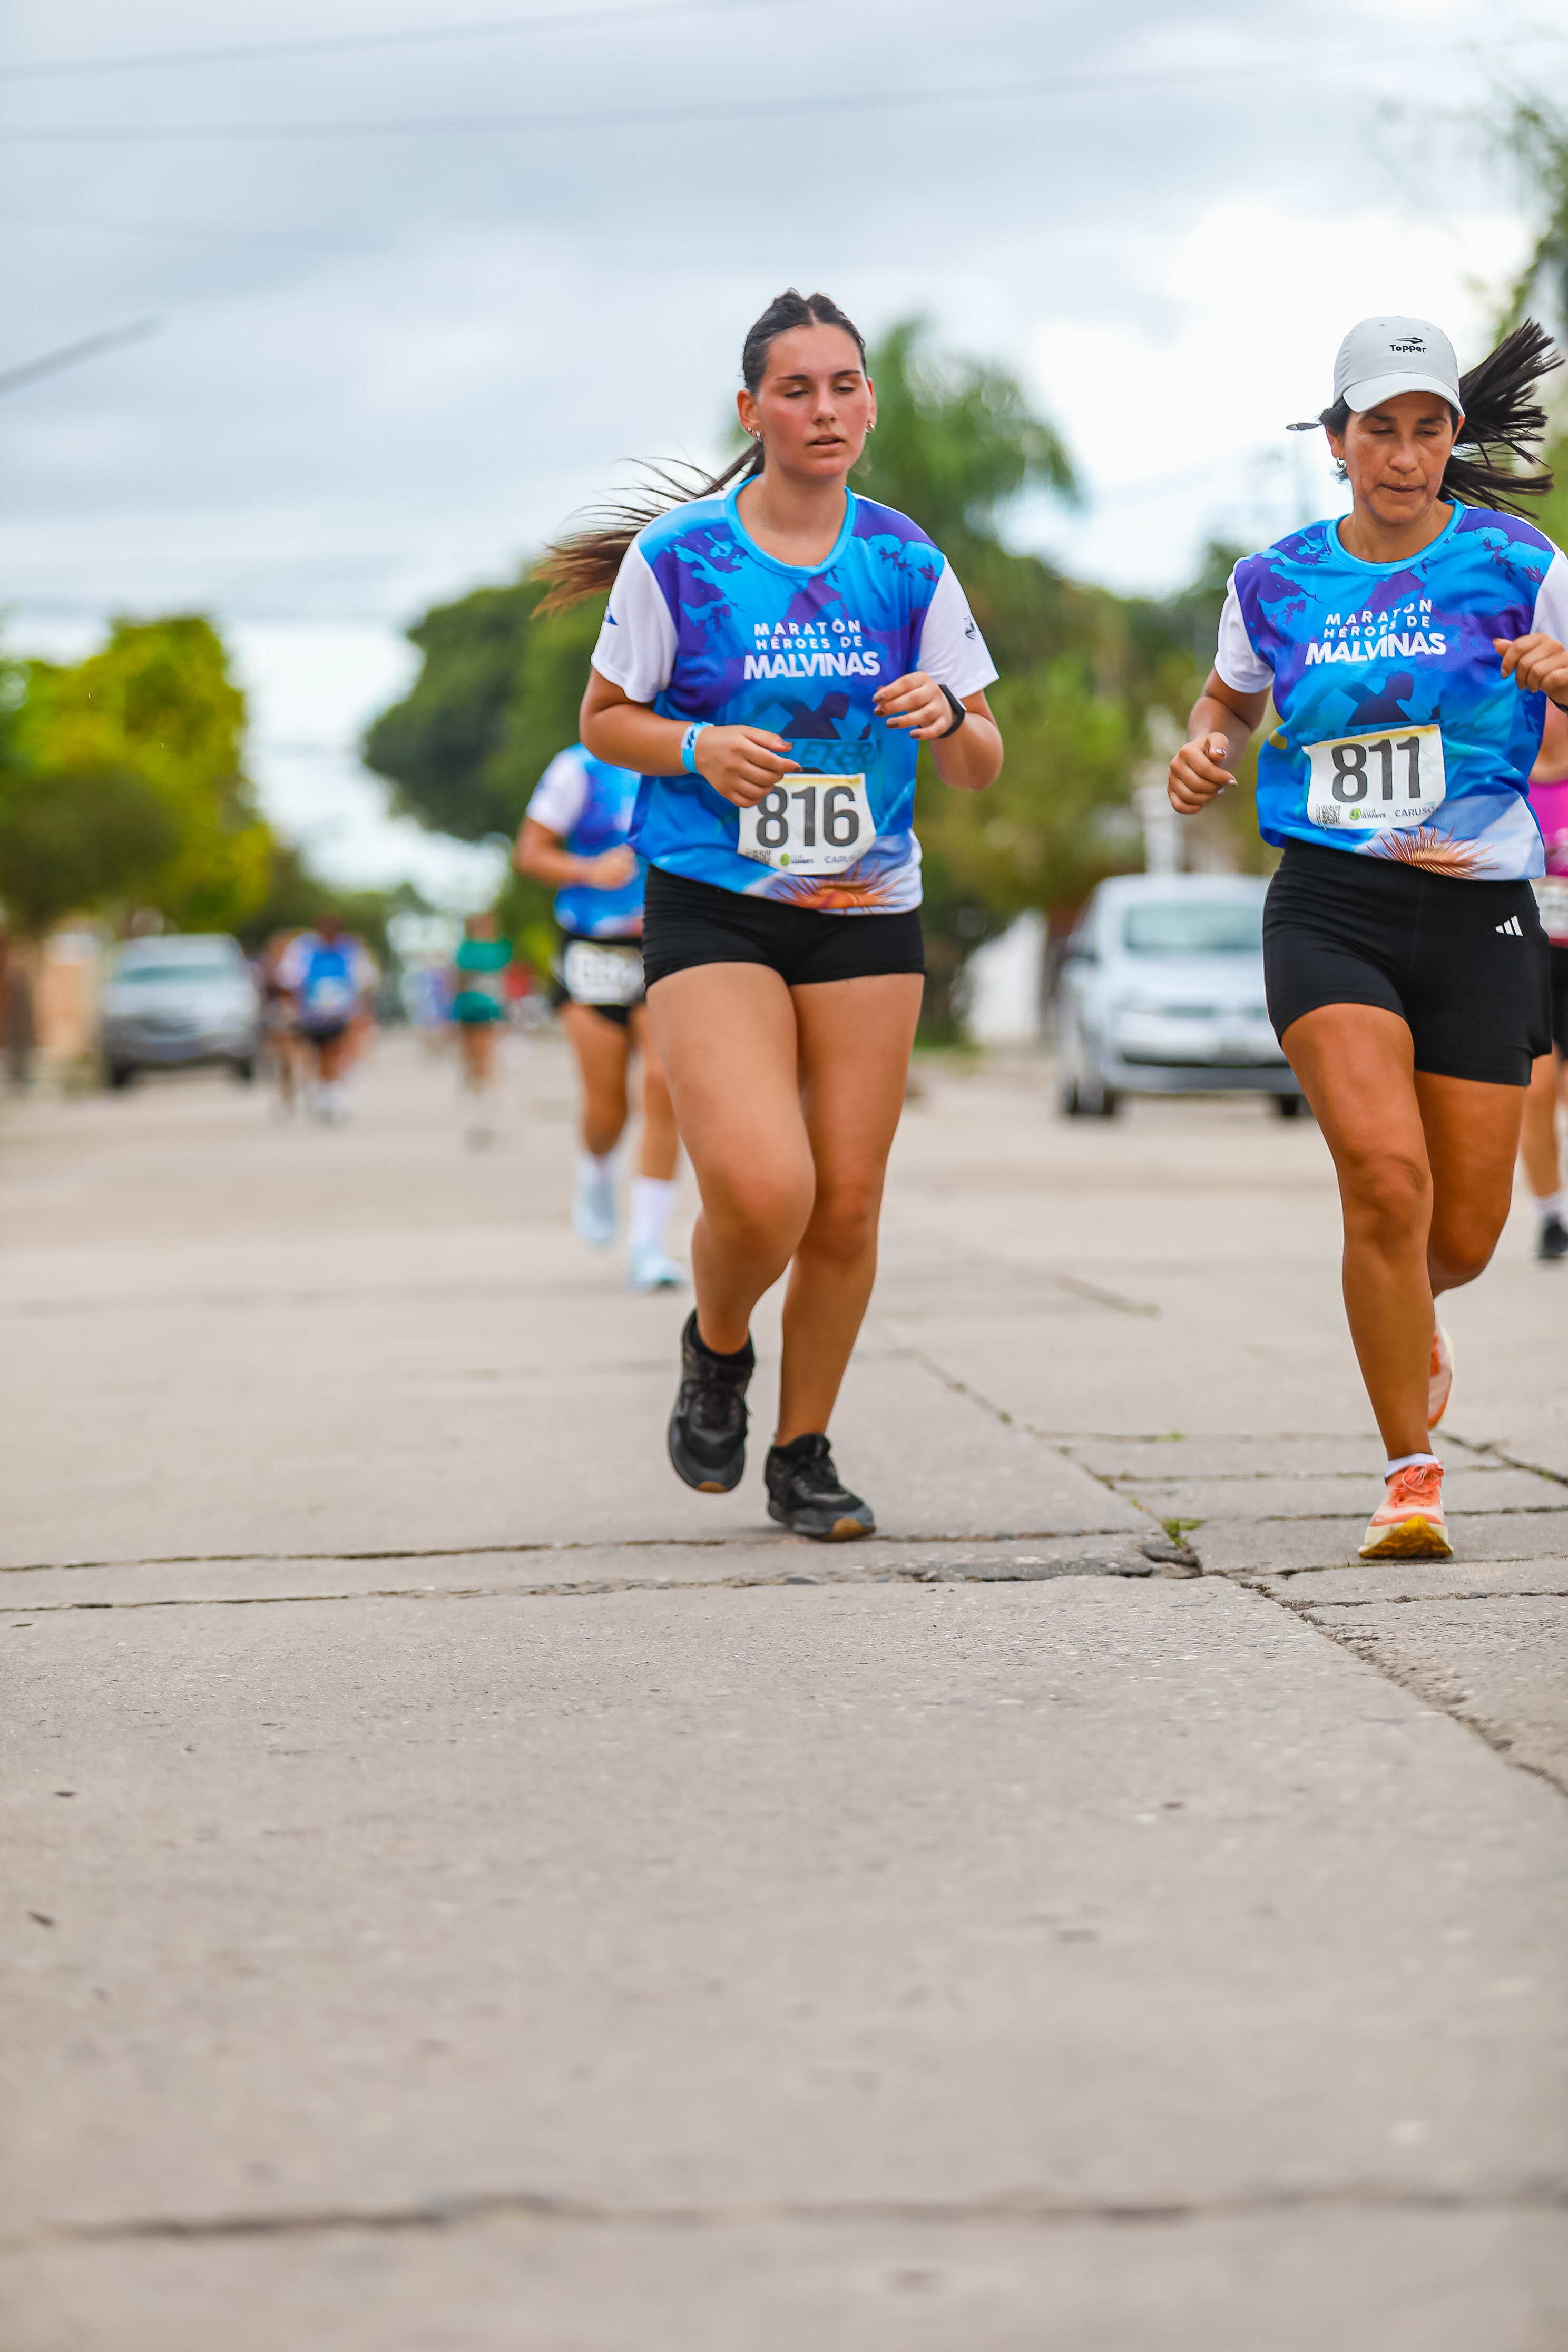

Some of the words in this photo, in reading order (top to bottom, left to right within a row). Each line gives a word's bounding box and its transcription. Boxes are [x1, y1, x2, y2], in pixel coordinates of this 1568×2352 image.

[1389, 344, 1427, 354] Topper
[753, 618, 862, 636] MARATÓN
[1406, 615, 1430, 628] DE
[756, 636, 831, 650] HÉROES
[840, 635, 863, 648] DE
[1305, 631, 1447, 666] MALVINAS
[743, 651, 881, 680] MALVINAS
[1331, 736, 1421, 803] 811
[757, 785, 859, 848] 816
[1395, 806, 1435, 817] CARUSO
